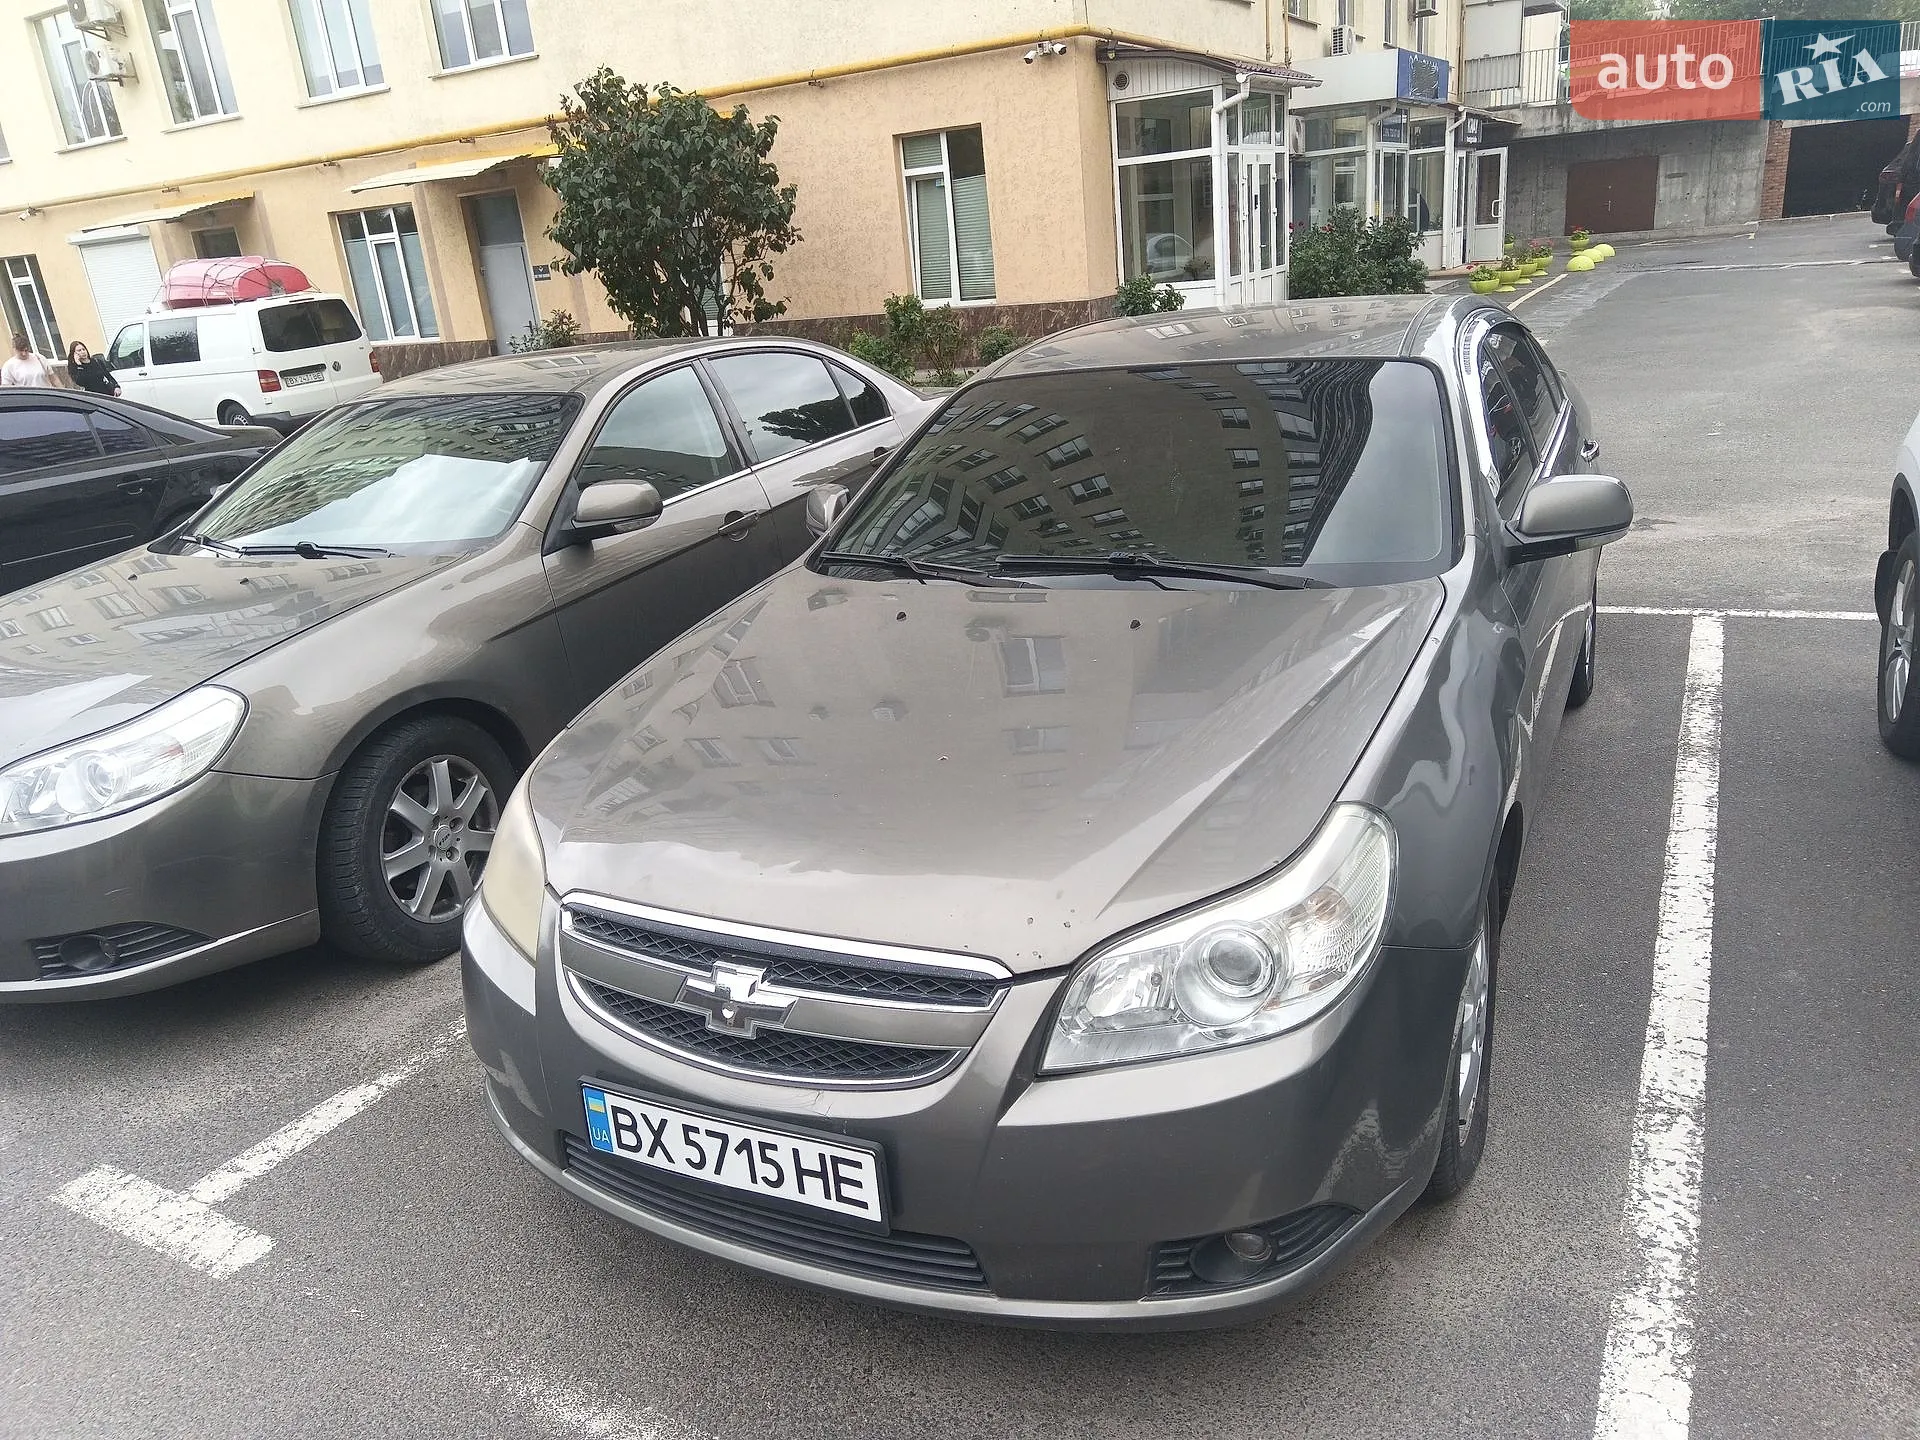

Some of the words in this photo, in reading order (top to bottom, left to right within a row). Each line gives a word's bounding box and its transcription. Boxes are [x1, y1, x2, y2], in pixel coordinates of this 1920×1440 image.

[593, 1128, 610, 1144] UA
[611, 1105, 675, 1164] BX
[682, 1123, 784, 1189] 5715
[792, 1147, 869, 1210] HE
